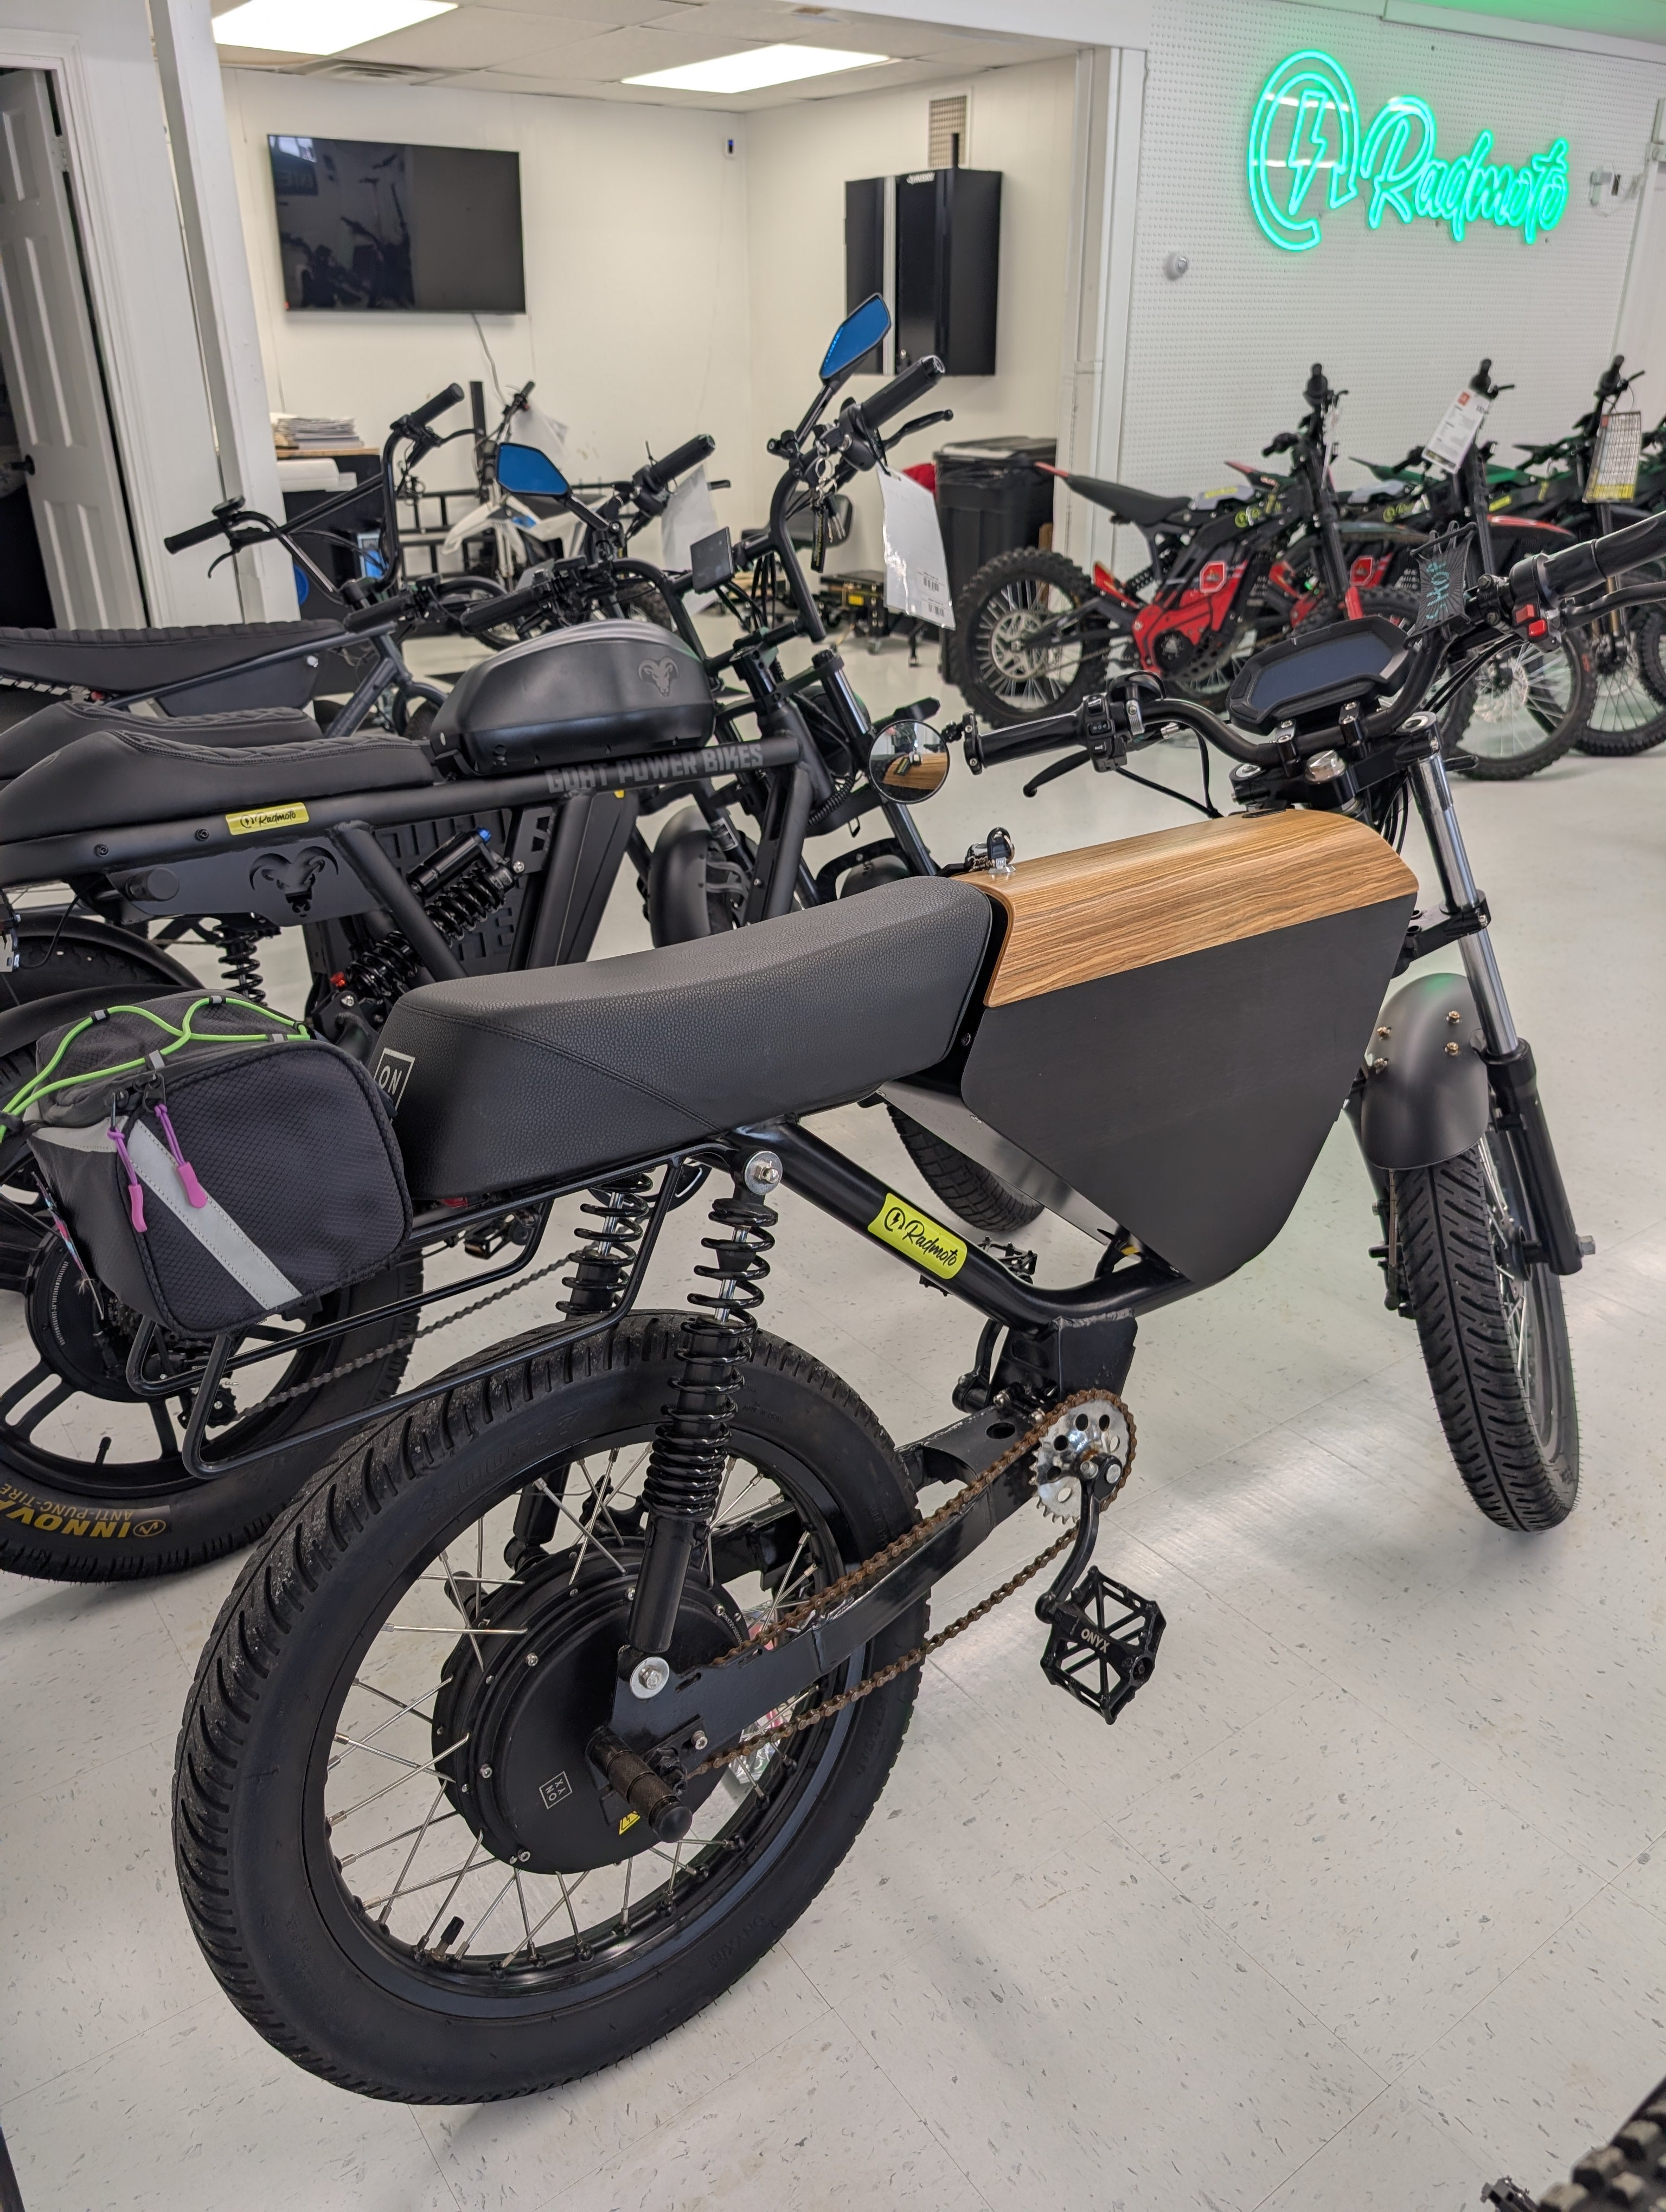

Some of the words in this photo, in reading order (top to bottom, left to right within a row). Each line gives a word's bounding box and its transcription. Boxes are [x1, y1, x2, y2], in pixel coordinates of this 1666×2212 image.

[1360, 95, 1569, 244] Radmoto
[618, 750, 698, 784] POWER
[702, 743, 764, 772] BIKES
[255, 810, 296, 827] Radmoto
[378, 1065, 402, 1095] ON
[902, 1220, 958, 1266] Radmoto
[0, 1483, 136, 1521] ANTI-PUNC-TIRE
[1081, 1628, 1110, 1654] ONYX
